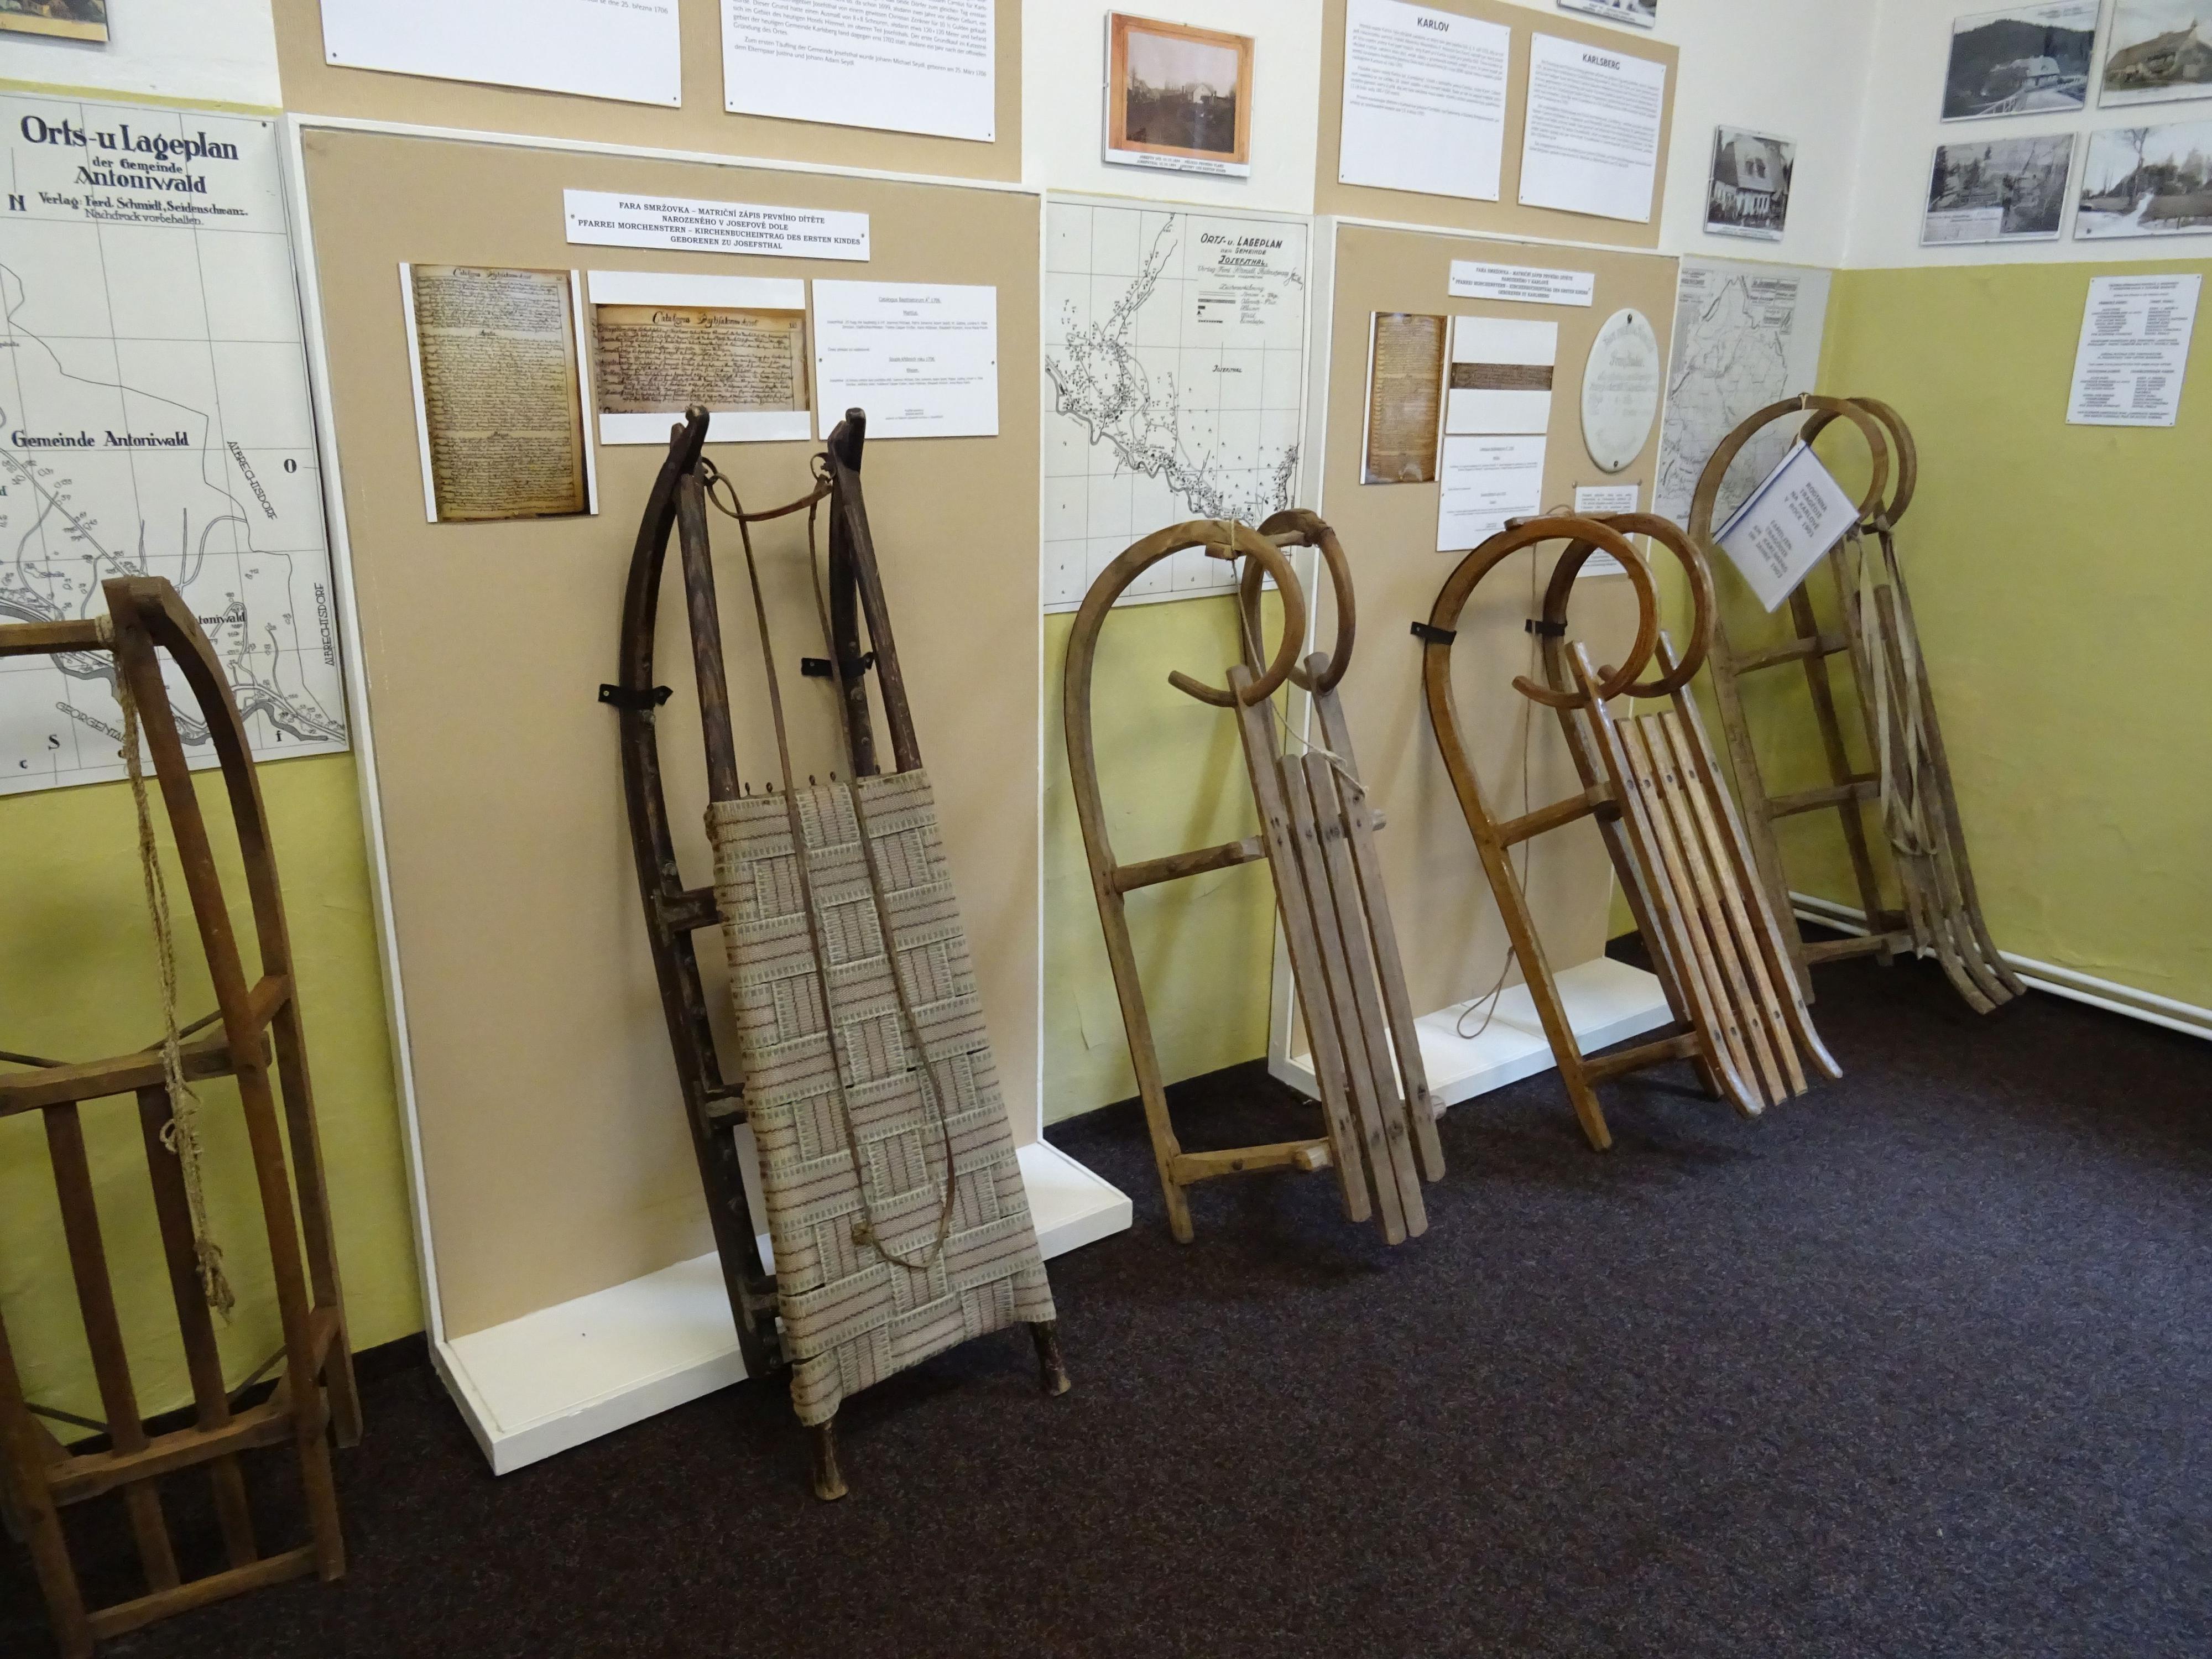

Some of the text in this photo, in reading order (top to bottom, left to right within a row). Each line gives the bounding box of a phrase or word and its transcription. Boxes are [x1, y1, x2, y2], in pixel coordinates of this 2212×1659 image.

[632, 3, 652, 12] března
[654, 6, 669, 14] 1706
[813, 25, 837, 36] Karlsberg
[1417, 17, 1450, 33] KARLOV
[806, 54, 824, 62] Johann
[825, 56, 840, 64] Adam
[807, 45, 834, 54] Gemeinde
[834, 49, 858, 58] Josefsthal
[875, 55, 893, 64] Johann
[893, 58, 911, 66] Michael
[1582, 53, 1620, 71] KARLSBERG
[119, 124, 239, 162] Lageplan
[92, 156, 183, 174] der Gemeinde
[74, 166, 208, 194] Antoniwald
[8, 194, 27, 211] N
[619, 202, 825, 224] FARA SMRŽOVKA MATRIČNÍ ZÁPIS PRVNÍHO DÍTĚTE
[662, 215, 717, 226] NAROZENÉHO
[578, 219, 615, 229] PFARREI
[618, 222, 686, 233] MORCHENSTERN
[694, 227, 785, 240] KIRCHENBUCHEINTRAG
[804, 235, 832, 243] ERSTEN
[670, 236, 719, 245] GEBORENEN
[733, 239, 783, 249] JOSEFSTHAL
[1237, 236, 1283, 249] LAGEPLAN
[11, 430, 190, 448] Gemeinde Antoniwald
[198, 612, 246, 624] toniwald
[48, 734, 61, 750] S
